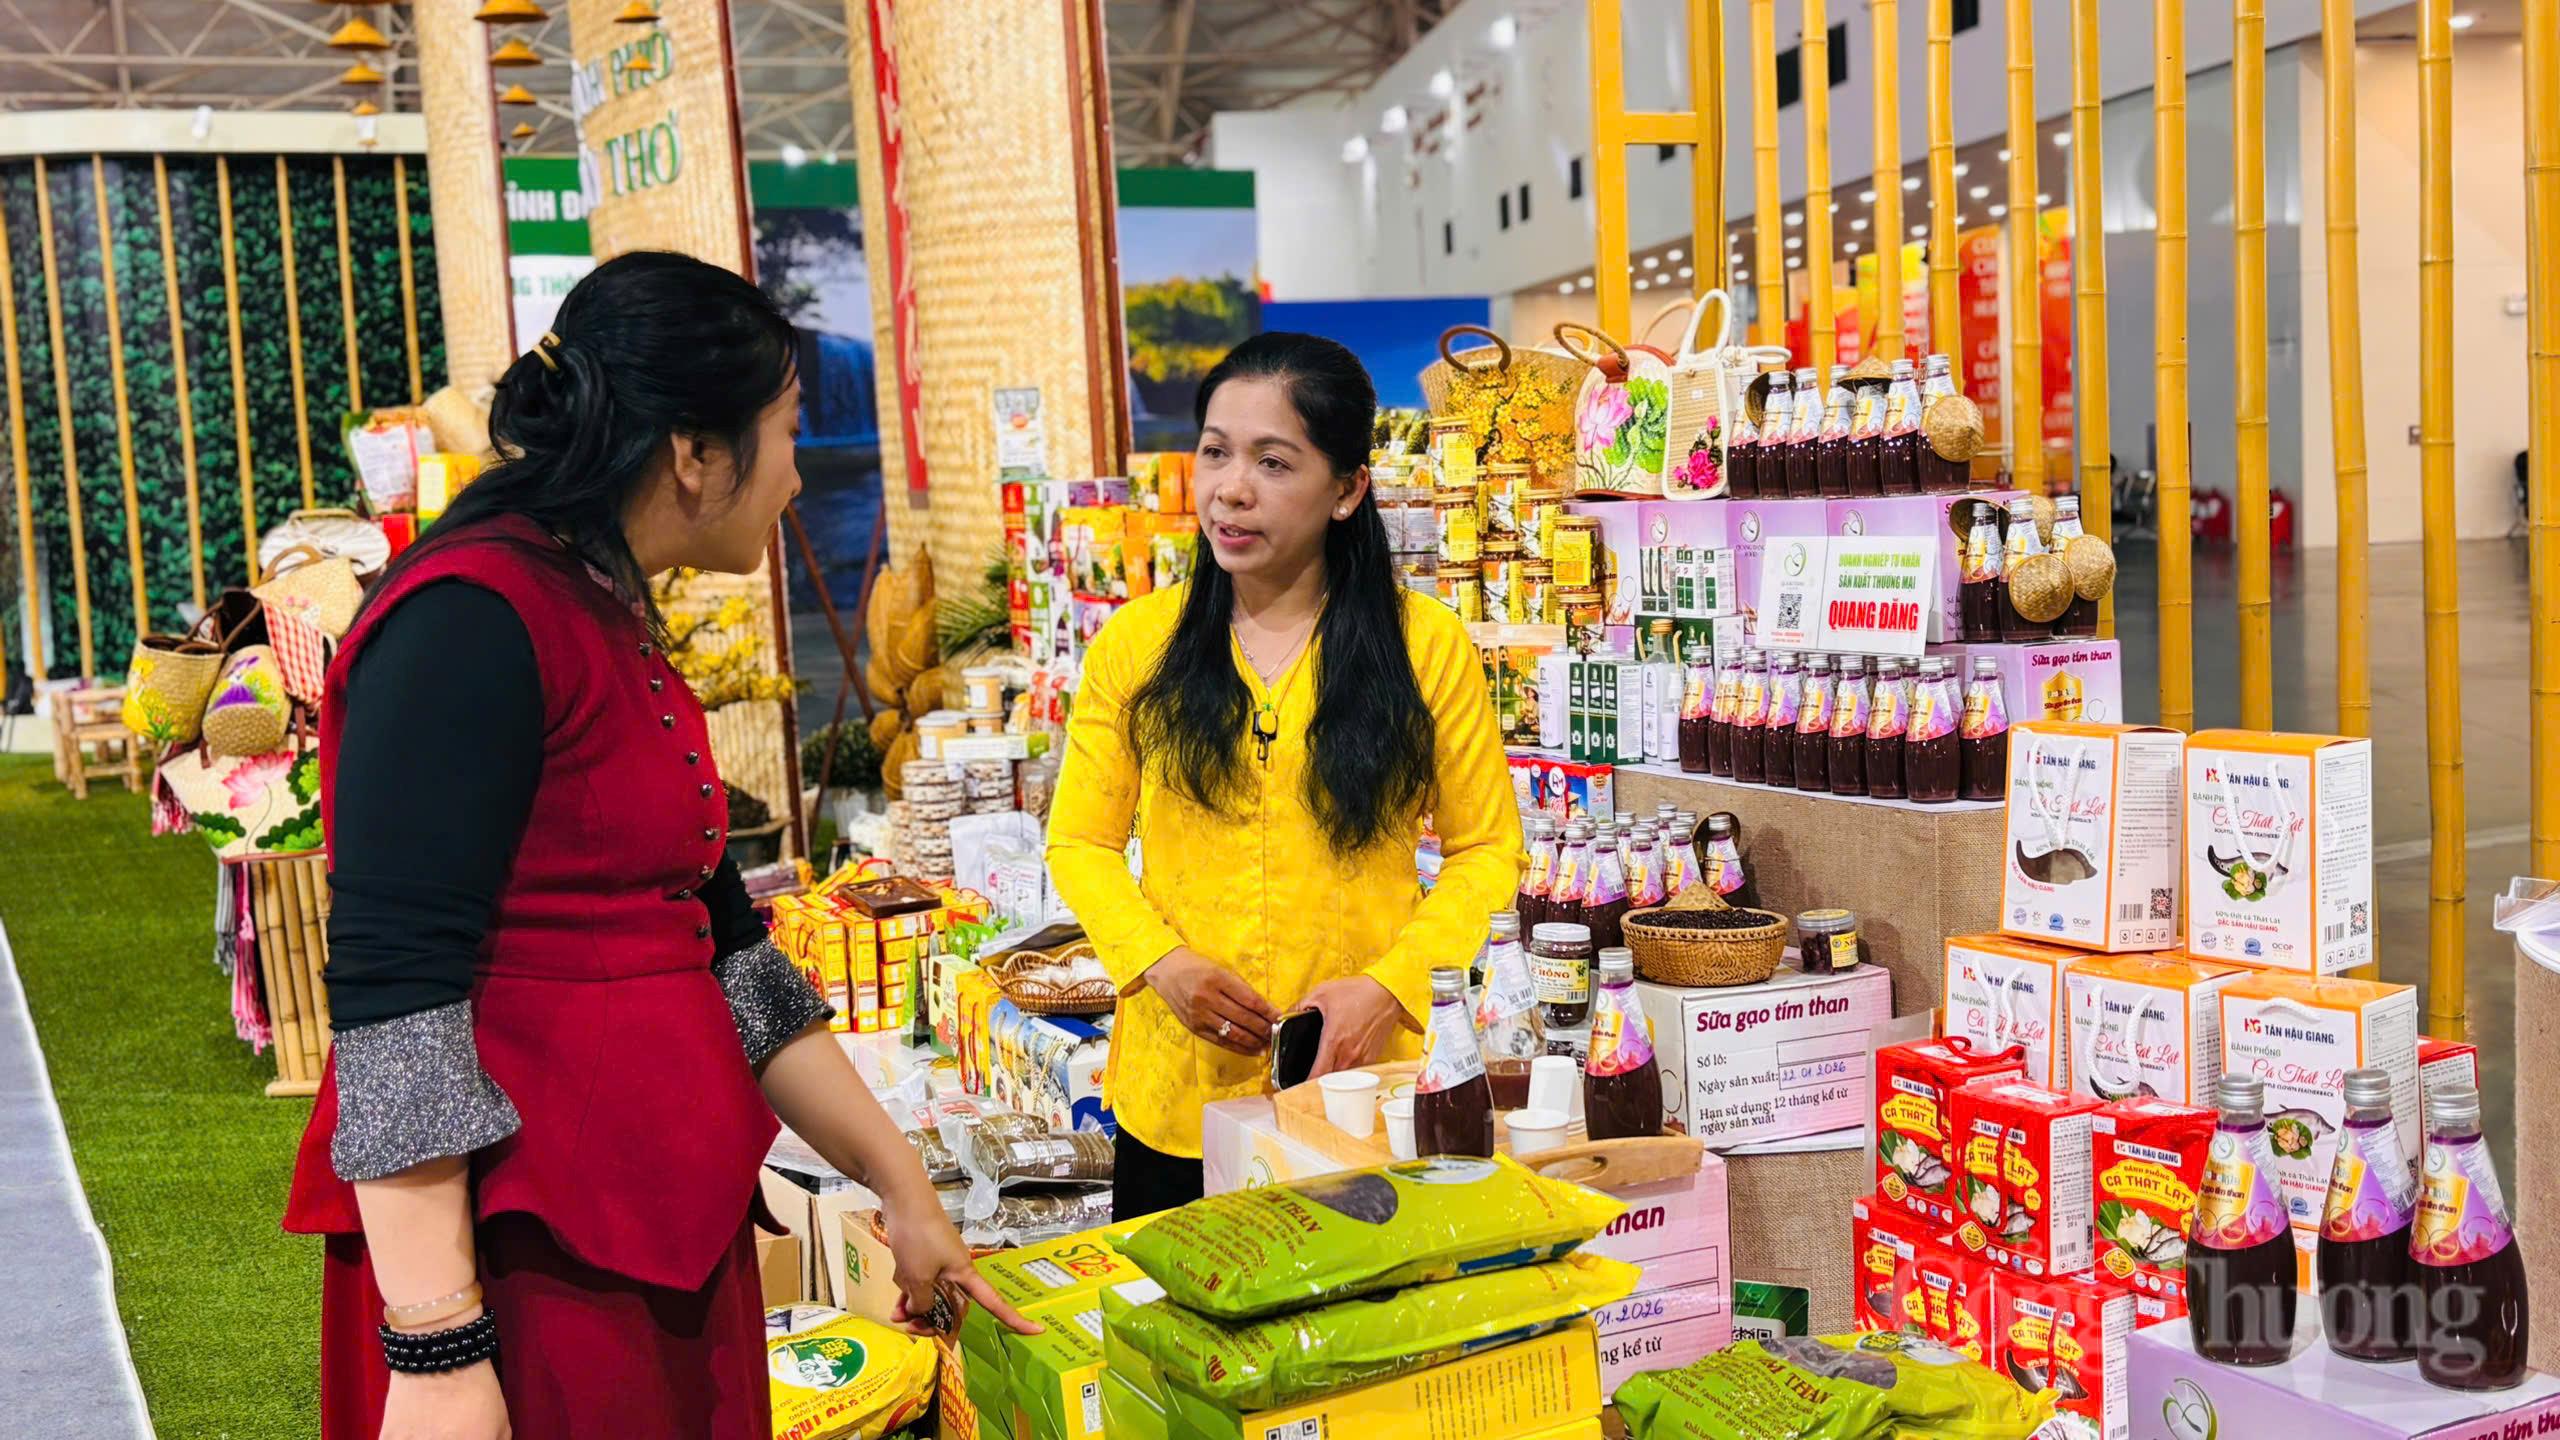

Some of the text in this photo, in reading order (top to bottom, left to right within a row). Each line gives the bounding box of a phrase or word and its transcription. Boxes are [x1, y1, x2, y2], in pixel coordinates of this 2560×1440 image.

[1829, 600, 1877, 630] QUANG
[1879, 598, 1919, 630] ĐĂNG
[2032, 649, 2112, 667] Sữa gạo tím than
[2243, 774, 2261, 789] HẬU
[2271, 941, 2294, 951] OCOP
[2011, 979, 2035, 994] GIANG
[1696, 996, 1849, 1032] Sữa gạo tím than
[2265, 1024, 2282, 1038] TÂN
[2284, 1027, 2304, 1043] HẬU
[2305, 1030, 2335, 1045] GIANG
[1697, 1053, 1727, 1068] Số lô:
[1816, 1061, 1847, 1076] 2026
[1698, 1070, 1779, 1095] Ngày sản xuất:
[1700, 1087, 1849, 1121] Hạn sử dụng: 12 tháng kể từ
[1700, 1112, 1776, 1136] ngày sản xuất
[2127, 1144, 2140, 1156] TÂN
[2157, 1151, 2179, 1165] GIANG
[1053, 1243, 1121, 1278] ST25
[1623, 1336, 1643, 1359] kể
[1644, 1335, 1663, 1353] từ
